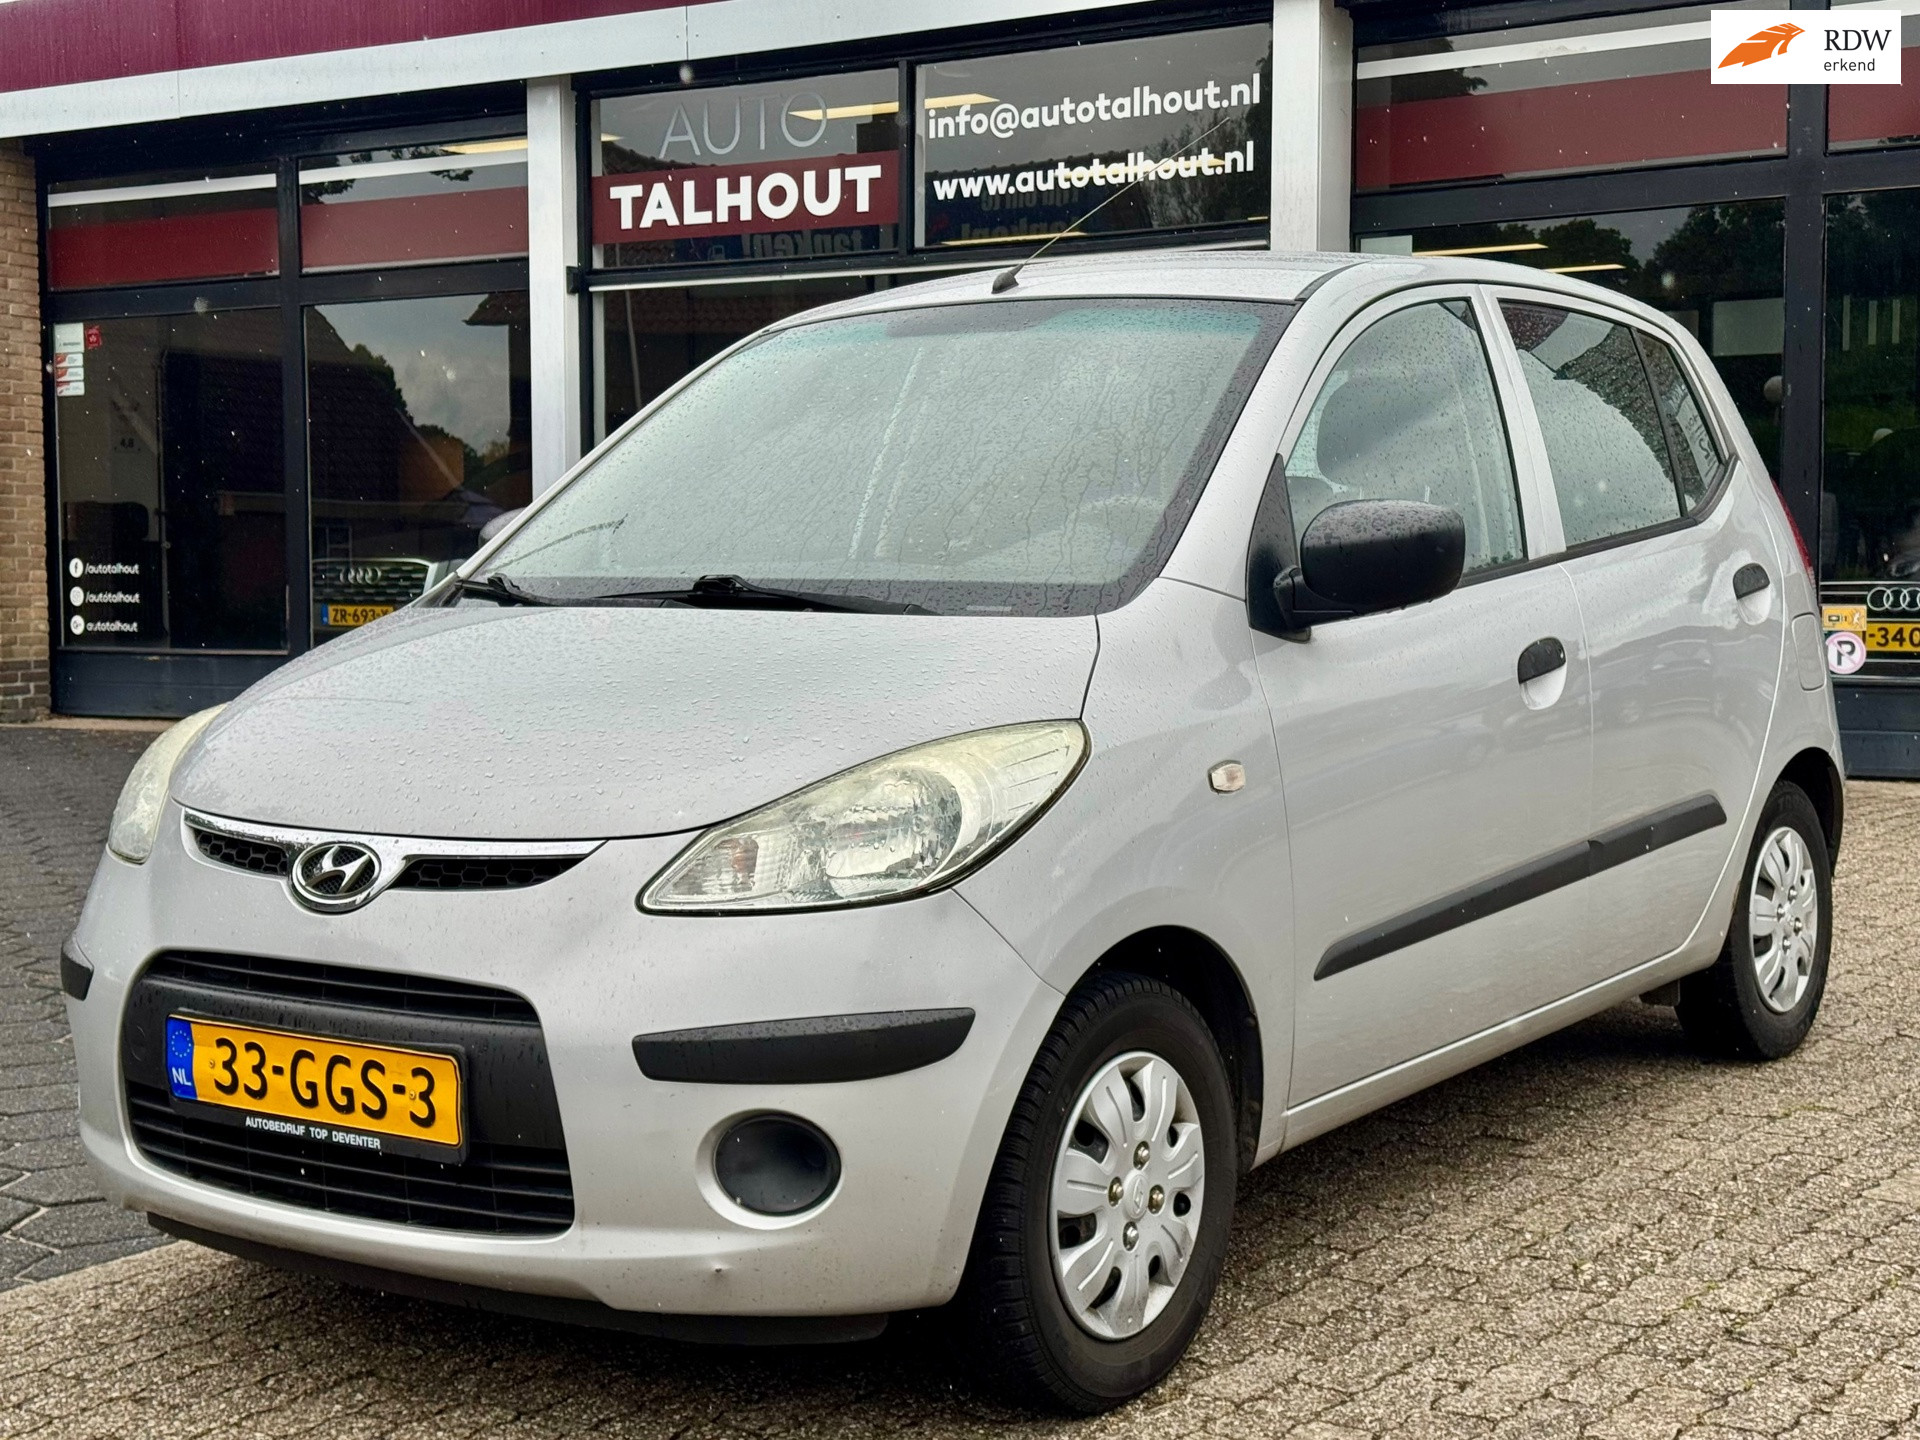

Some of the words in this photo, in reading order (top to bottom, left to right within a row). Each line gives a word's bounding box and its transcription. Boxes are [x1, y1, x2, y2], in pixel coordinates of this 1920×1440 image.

[659, 91, 829, 160] AUTO
[927, 73, 1262, 140] info@autotalhout.nl
[609, 165, 882, 231] TALHOUT
[932, 141, 1255, 202] www.autotalhout.nl
[172, 1067, 192, 1087] NL
[213, 1037, 436, 1128] 33-GGS-3
[245, 1116, 306, 1137] AUTOBEDRIJF
[310, 1127, 328, 1141] TOP
[332, 1131, 381, 1149] DEVENTER
